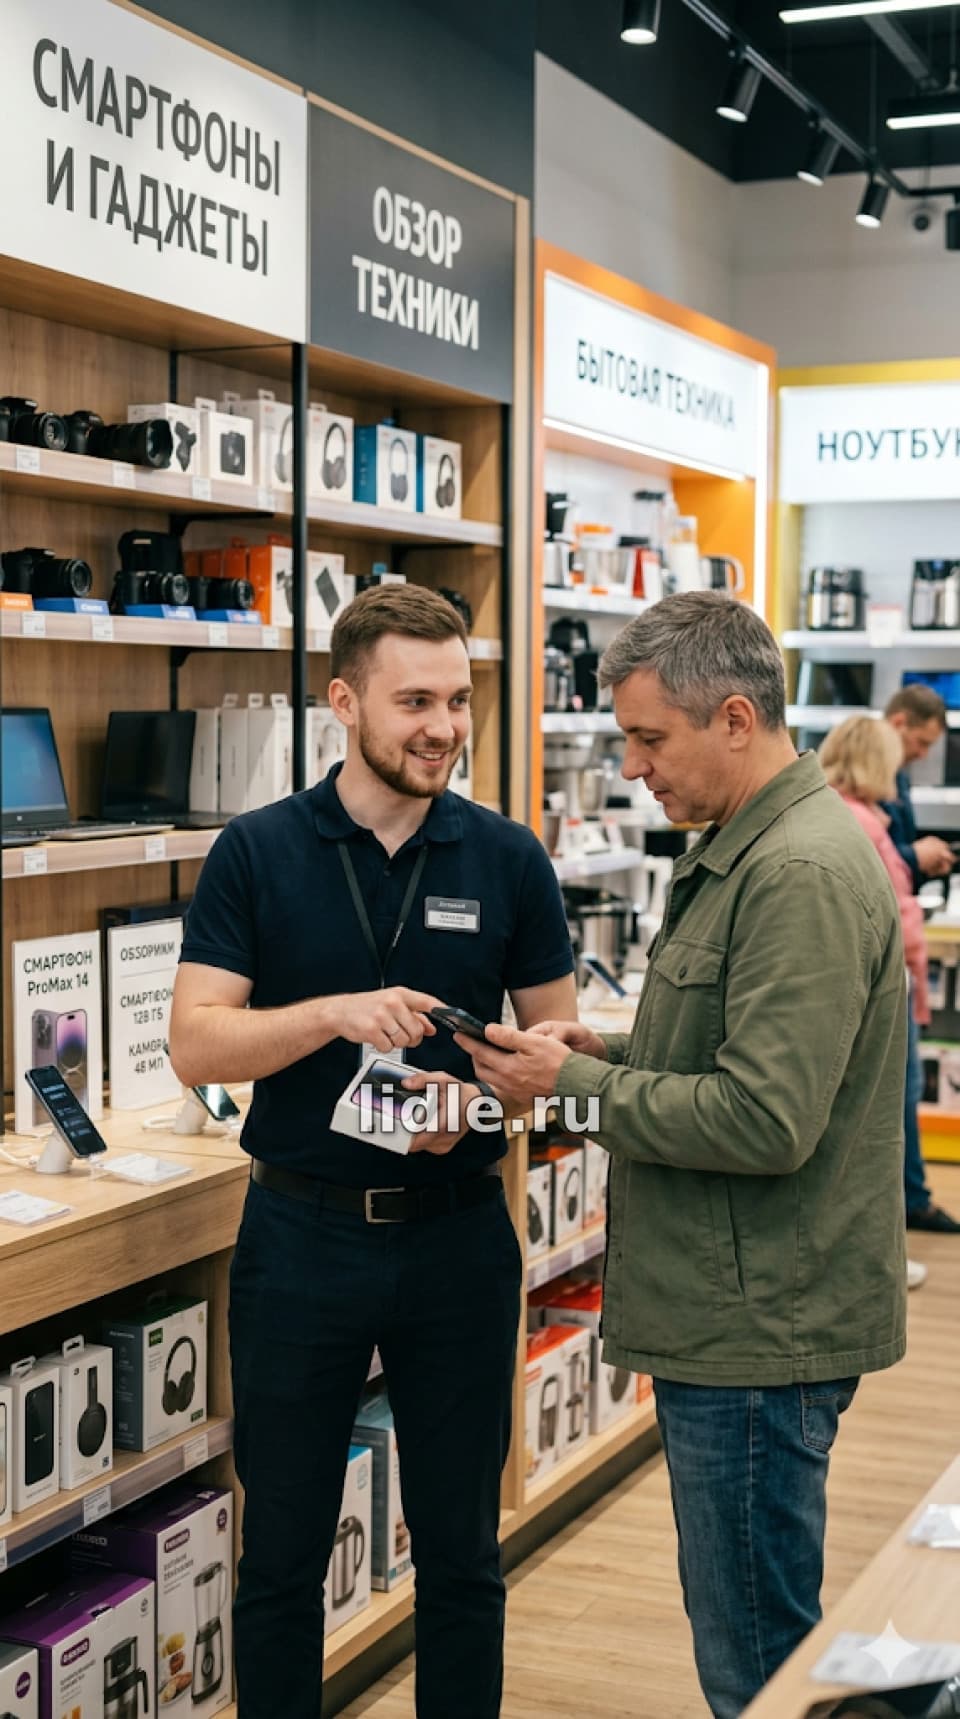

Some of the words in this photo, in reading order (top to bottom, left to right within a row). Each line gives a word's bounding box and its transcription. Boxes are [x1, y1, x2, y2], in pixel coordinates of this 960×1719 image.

[33, 38, 280, 196] СМАРТФОНЫ
[46, 138, 75, 212] И
[90, 154, 269, 276] ГАДЖЕТЫ
[373, 186, 462, 269] ОБЗОР
[352, 256, 479, 350] ТЕХНИКИ
[577, 339, 661, 407] БЫТОВАЯ
[666, 373, 736, 430] ТЕХНИКА
[28, 976, 73, 996] ProMax
[76, 972, 89, 987] 14
